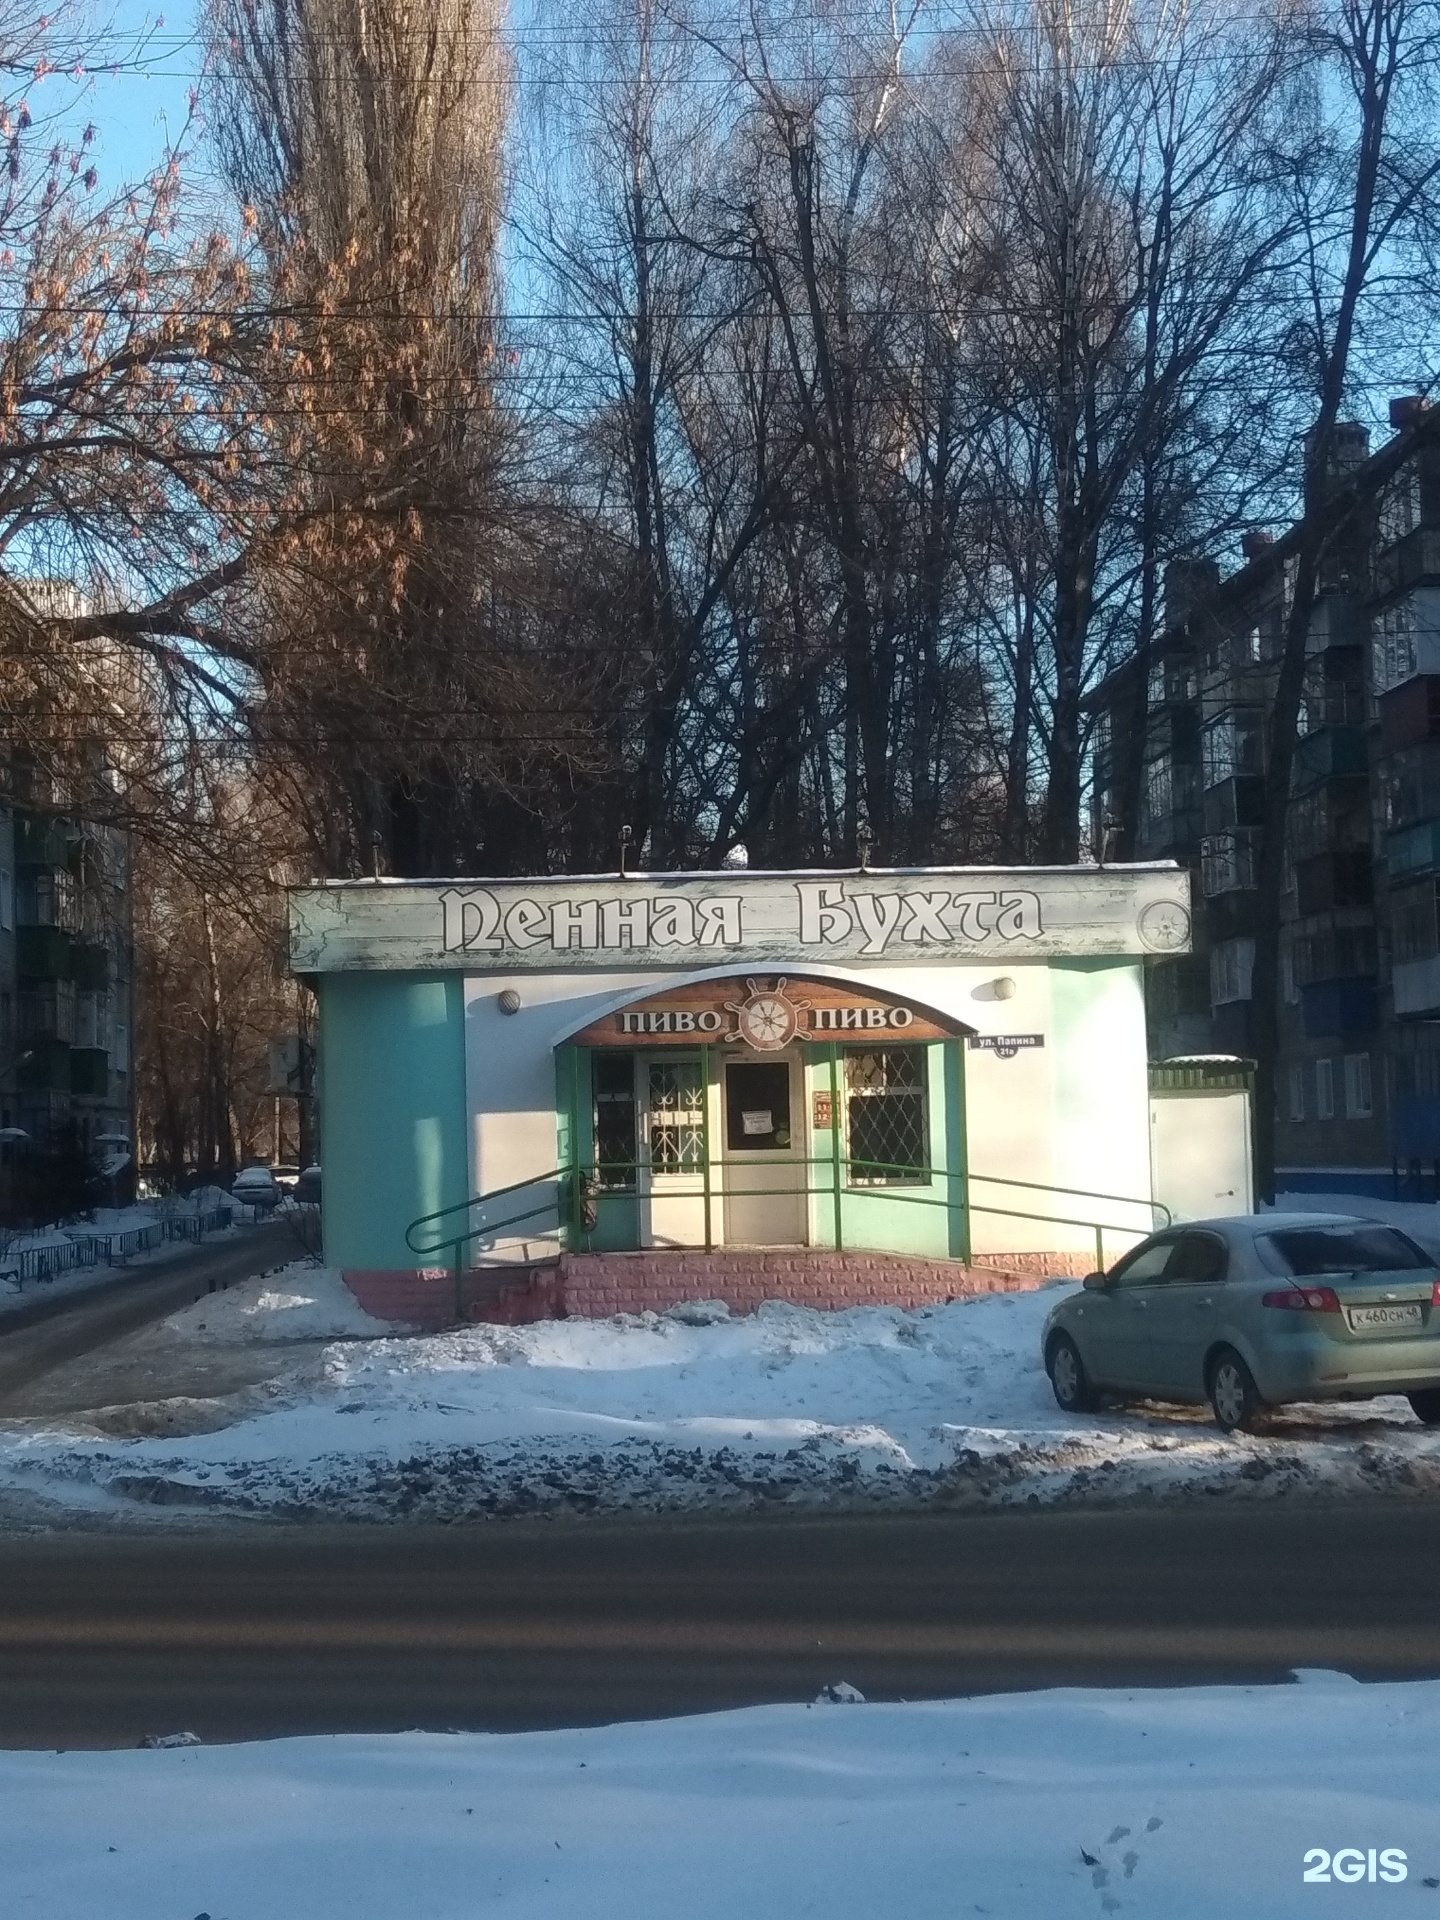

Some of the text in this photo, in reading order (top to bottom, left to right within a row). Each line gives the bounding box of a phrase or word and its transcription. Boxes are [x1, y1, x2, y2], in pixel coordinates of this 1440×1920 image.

[439, 881, 1043, 954] Пенная Бухта
[979, 1036, 1036, 1047] ул. Папина
